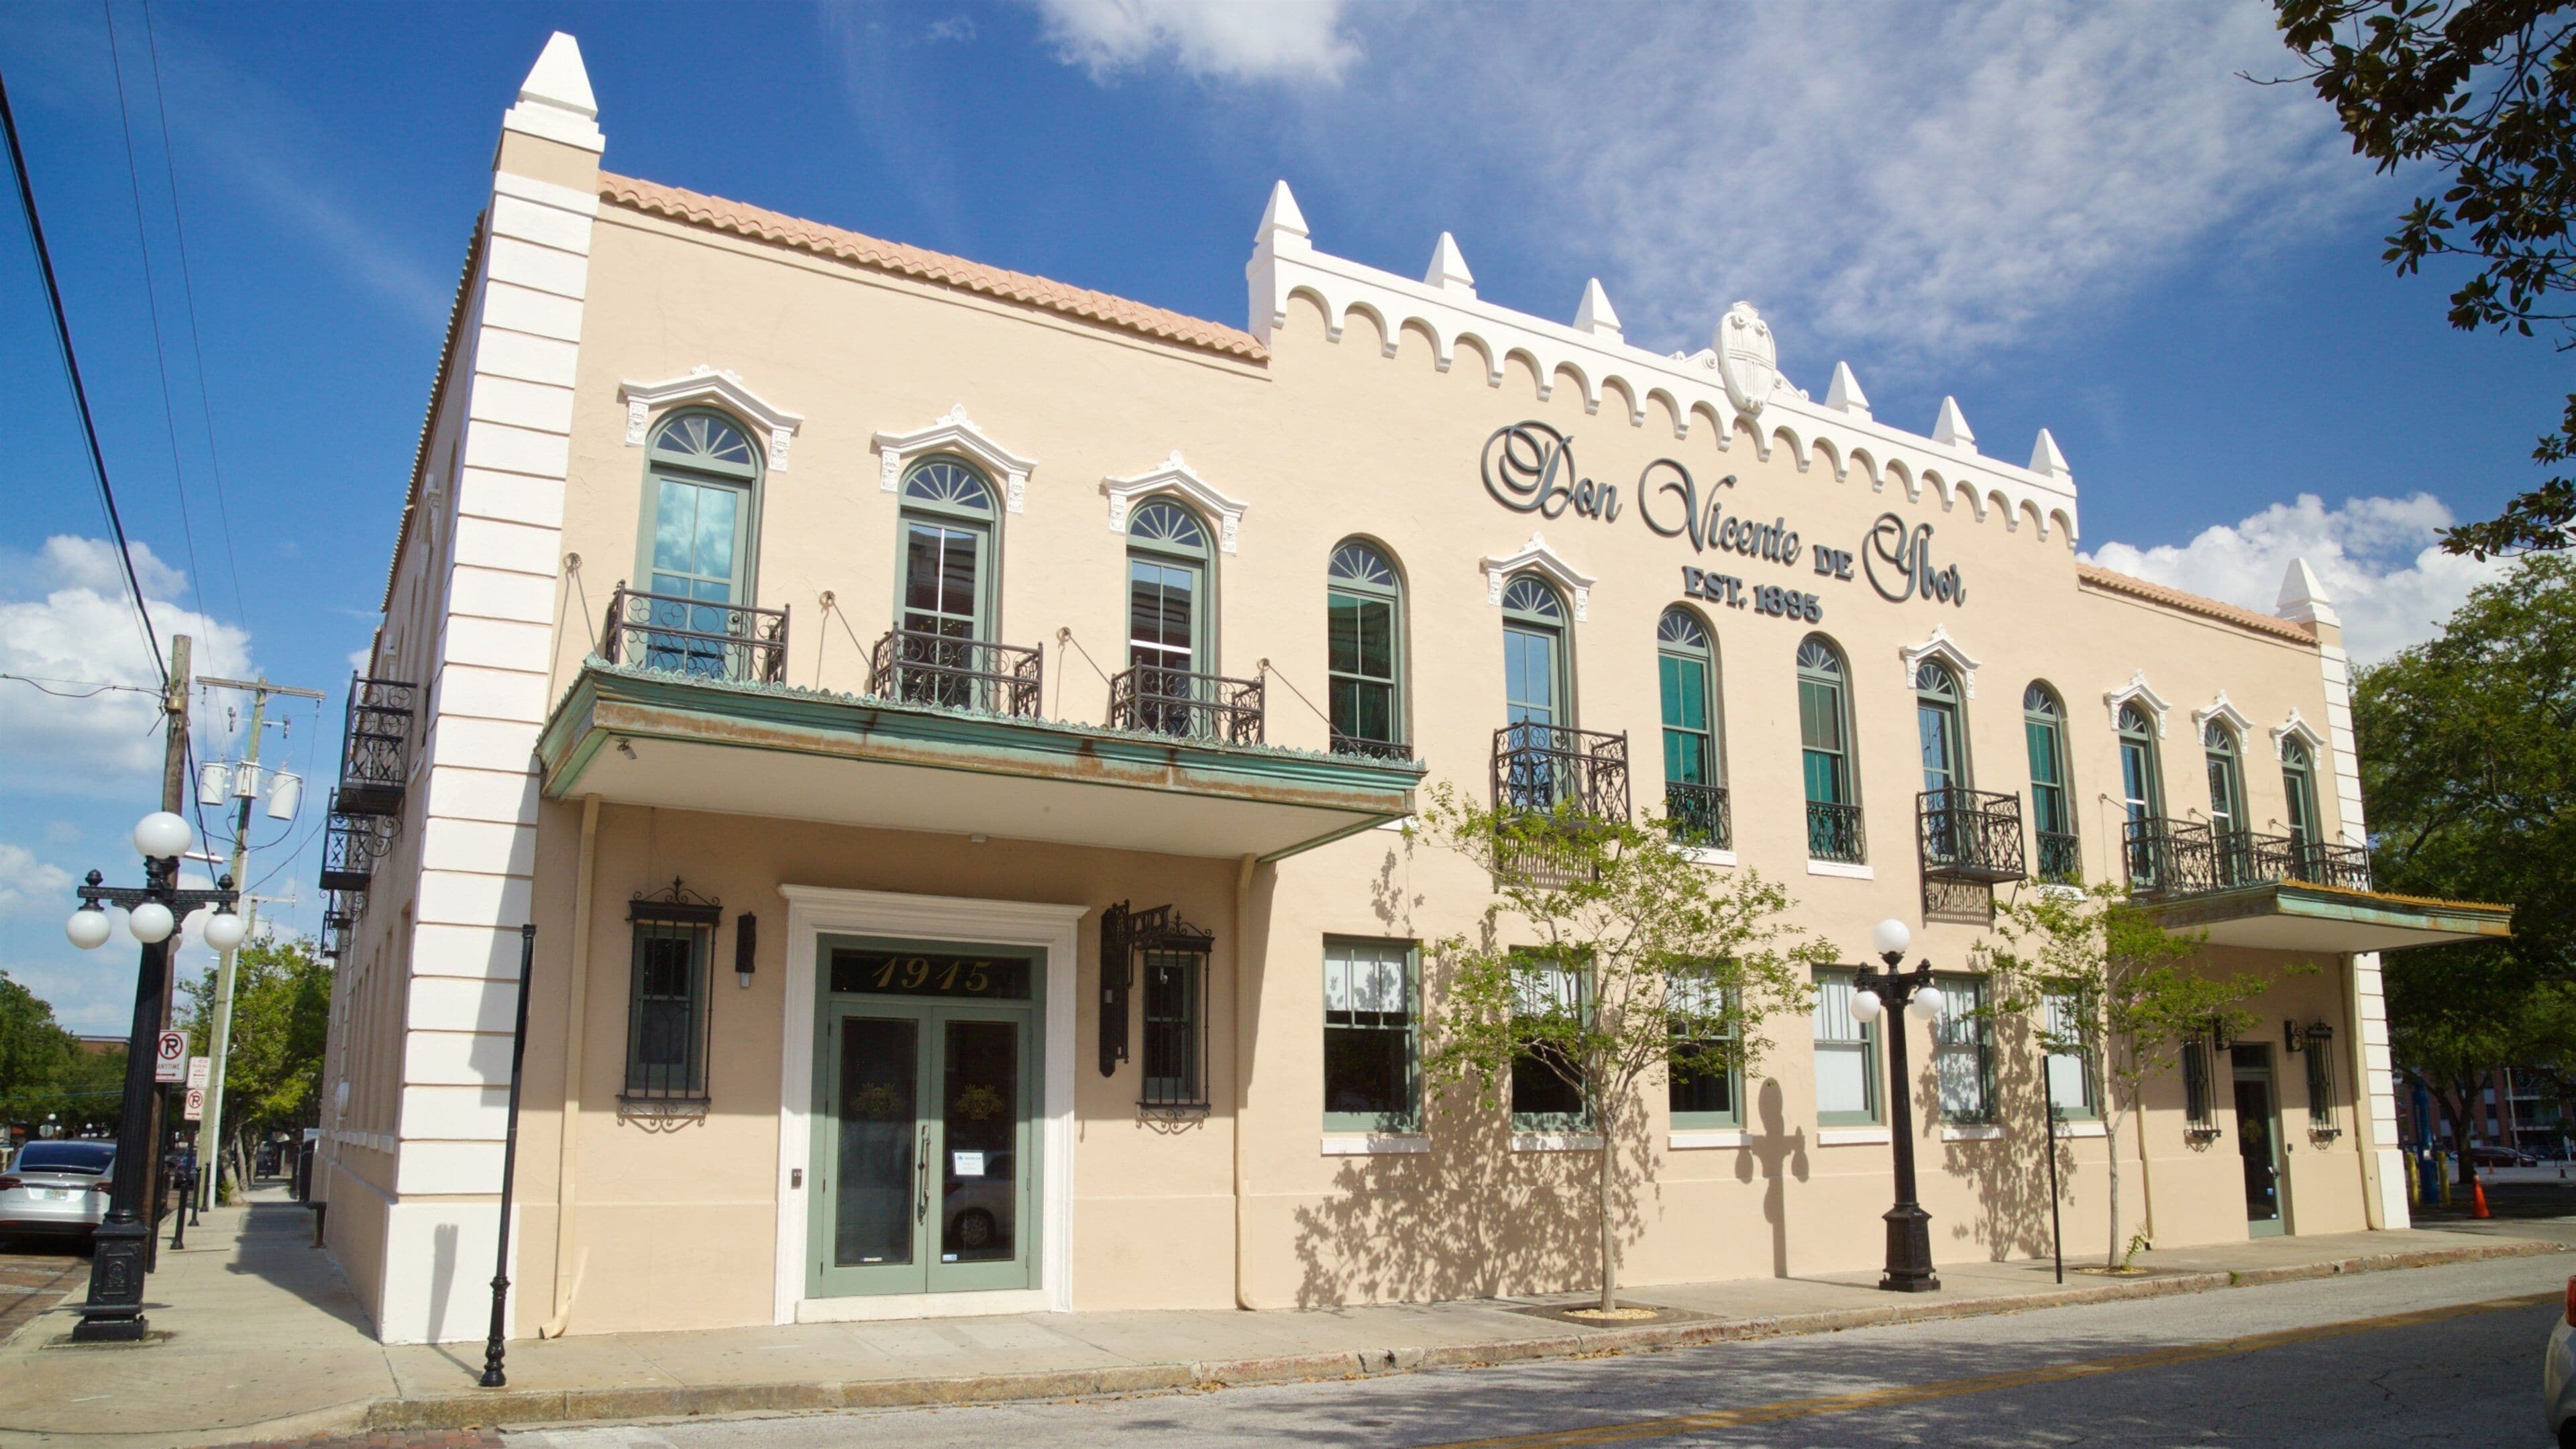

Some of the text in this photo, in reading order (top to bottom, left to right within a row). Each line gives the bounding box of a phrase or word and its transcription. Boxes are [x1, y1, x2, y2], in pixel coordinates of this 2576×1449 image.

[1481, 419, 1966, 608] Don Vicente DE Ybor
[1682, 565, 1823, 625] EST. 1895
[872, 956, 992, 991] 1915
